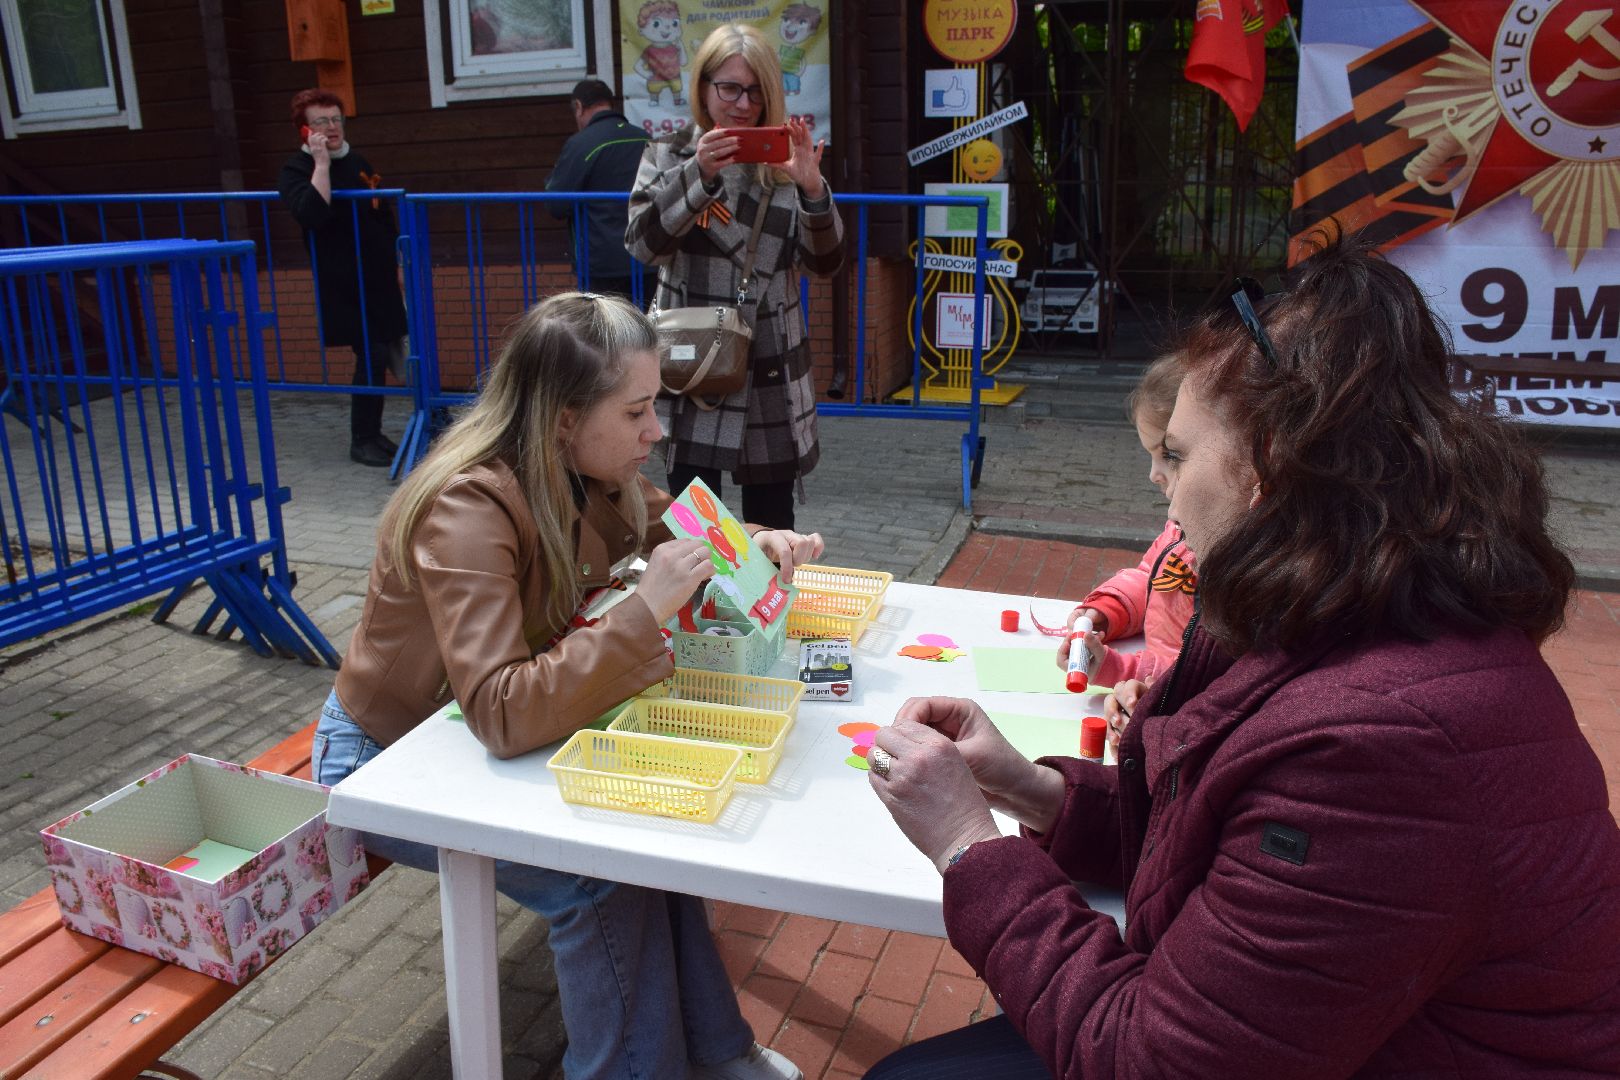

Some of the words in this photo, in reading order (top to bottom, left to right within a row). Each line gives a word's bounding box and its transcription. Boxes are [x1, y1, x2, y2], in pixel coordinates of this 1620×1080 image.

[686, 13, 707, 24] ДЛЯ
[709, 7, 770, 22] РОДИТЕЛЕЙ
[937, 7, 1004, 21] МУЗЫКА
[946, 26, 995, 41] ПАРК
[1500, 0, 1551, 137] ОТЕЧЕС
[911, 106, 1023, 162] #ПОДДЕРЖИЛАЙКОМ
[1460, 267, 1529, 343] 9
[761, 605, 771, 617] 9
